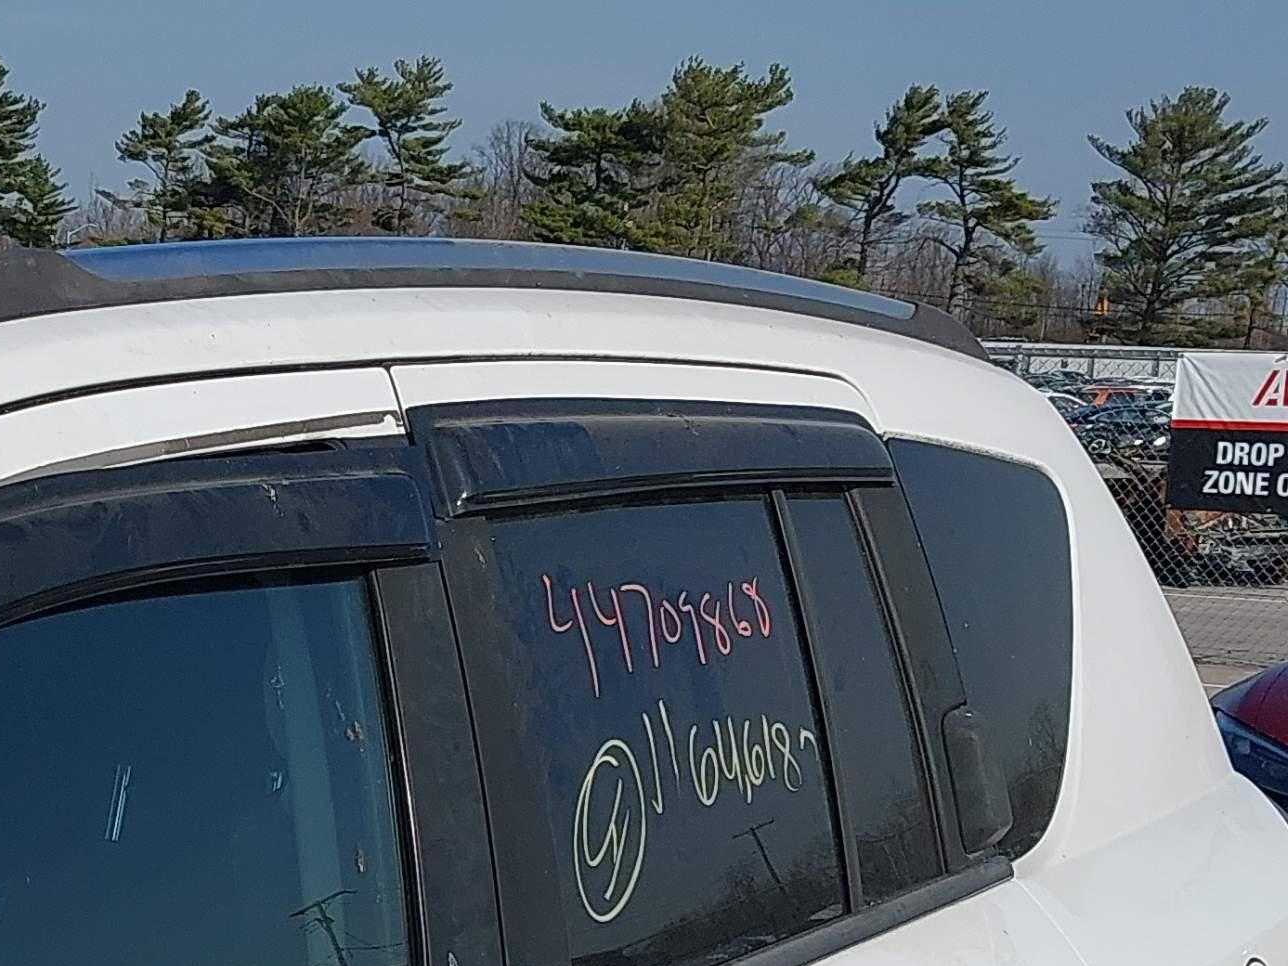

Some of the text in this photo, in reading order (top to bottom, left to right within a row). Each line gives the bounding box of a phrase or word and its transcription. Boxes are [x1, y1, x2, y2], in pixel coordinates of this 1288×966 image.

[1216, 441, 1285, 467] DROP
[1202, 470, 1271, 496] ZONE
[542, 574, 771, 698] 44709868
